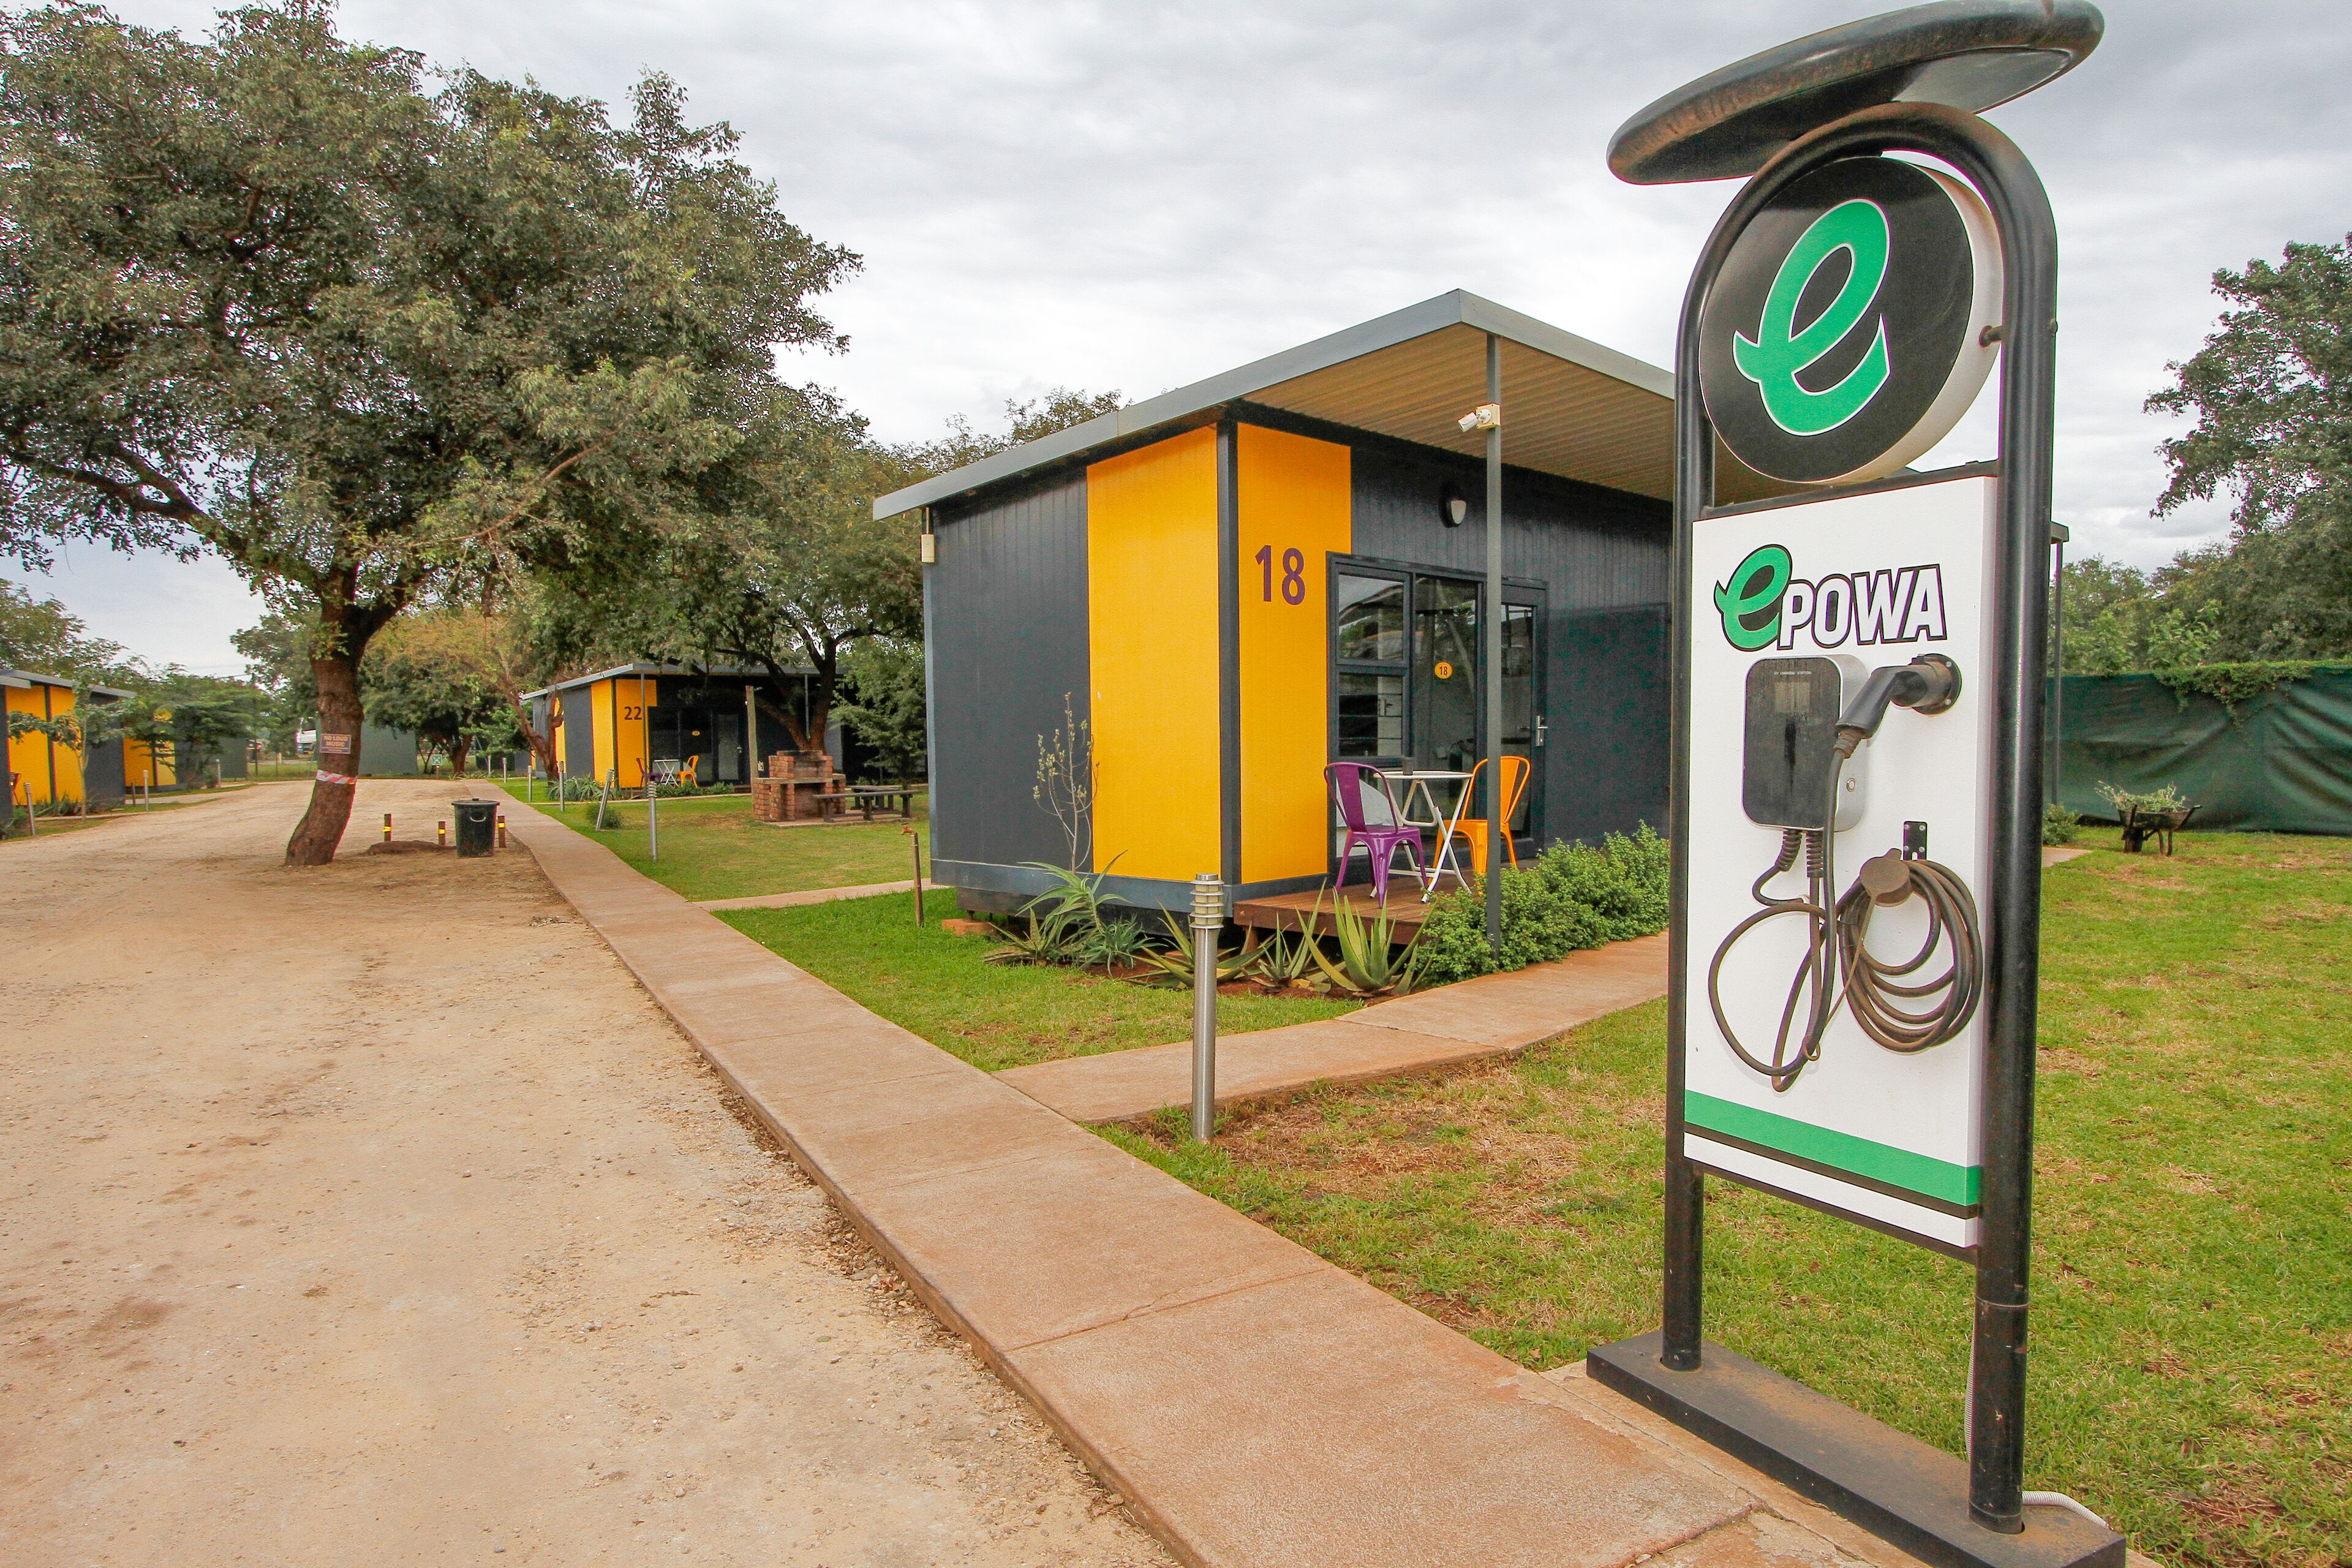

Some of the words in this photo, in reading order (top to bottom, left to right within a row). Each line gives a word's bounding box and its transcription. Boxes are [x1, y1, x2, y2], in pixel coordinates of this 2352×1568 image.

[1732, 198, 1891, 436] e
[1255, 545, 1306, 605] 18
[1439, 666, 1447, 676] 18
[624, 706, 642, 720] 22
